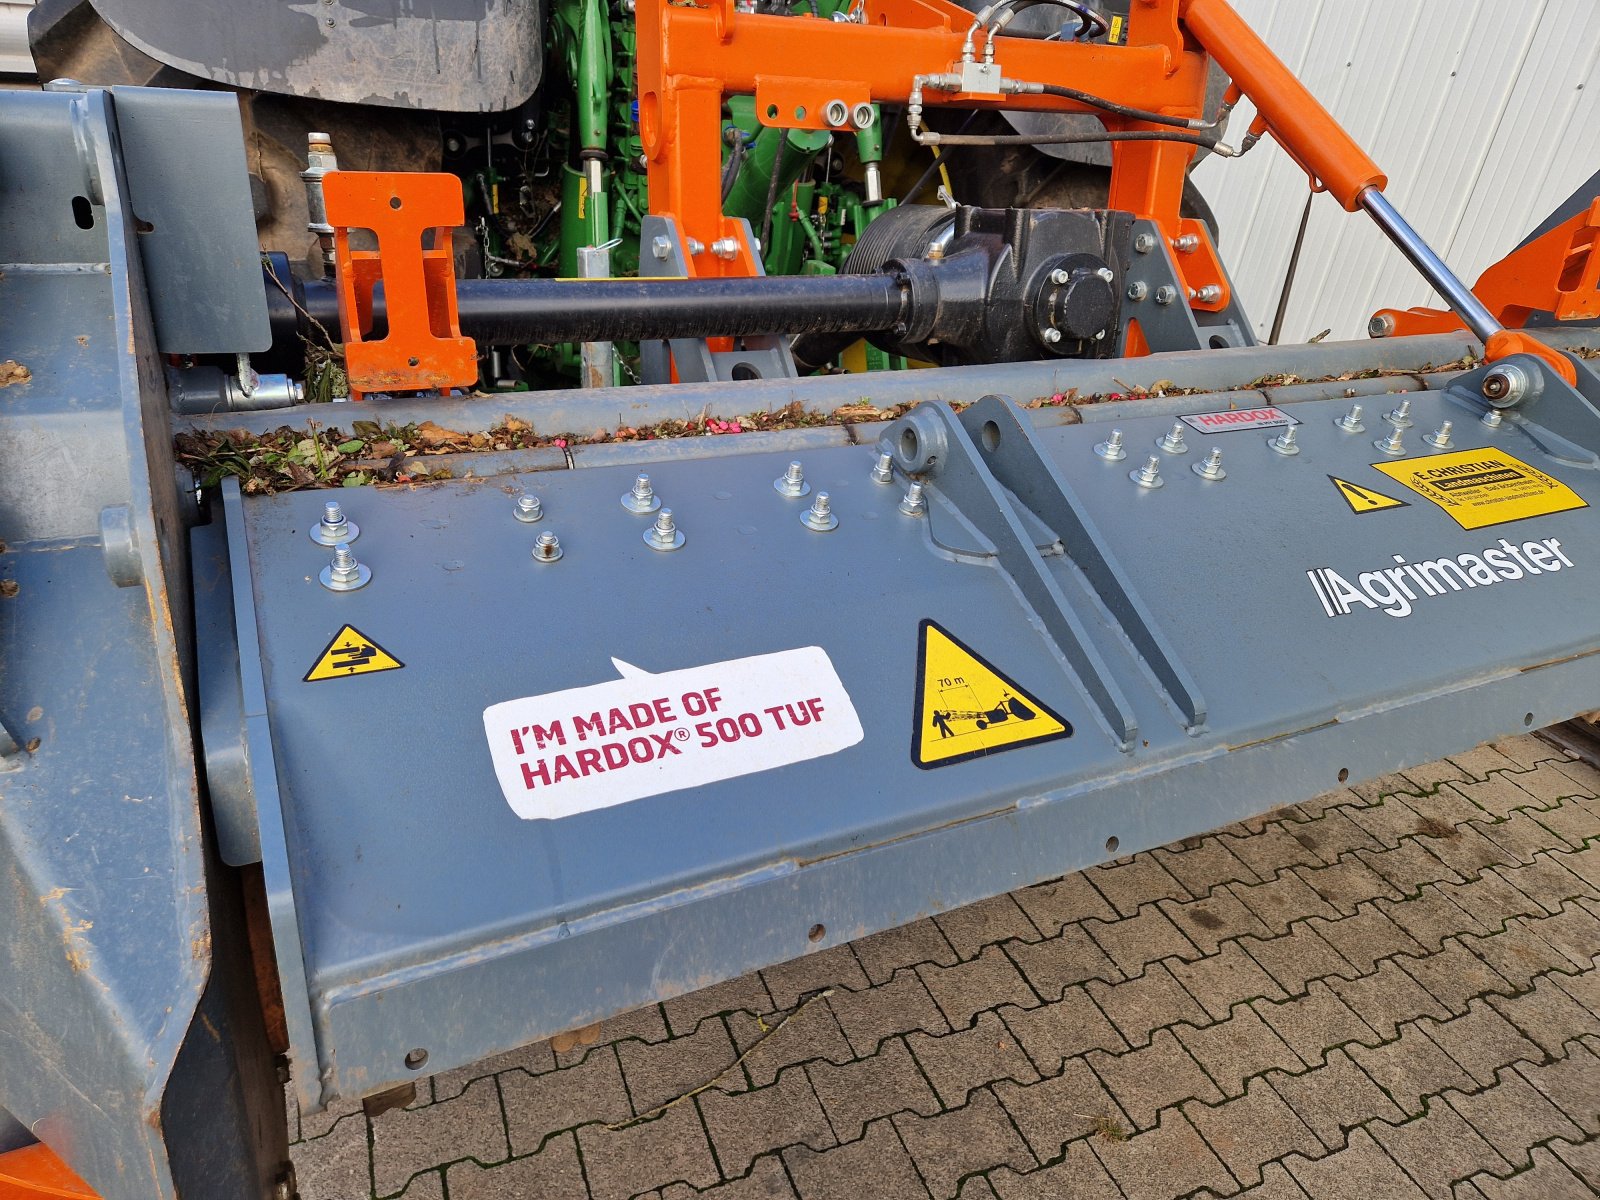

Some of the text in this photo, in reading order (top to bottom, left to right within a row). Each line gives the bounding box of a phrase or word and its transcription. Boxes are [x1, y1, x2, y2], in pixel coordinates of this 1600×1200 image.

[1198, 408, 1282, 426] HARDOX
[1413, 459, 1507, 481] E.CHRISTIAN
[1436, 471, 1520, 490] Landmaschinen
[1324, 538, 1574, 618] Agrimaster
[937, 675, 965, 688] 70 m
[573, 697, 677, 741] MADE
[681, 687, 723, 717] OF
[697, 712, 763, 748] 500
[764, 697, 826, 731] TUF
